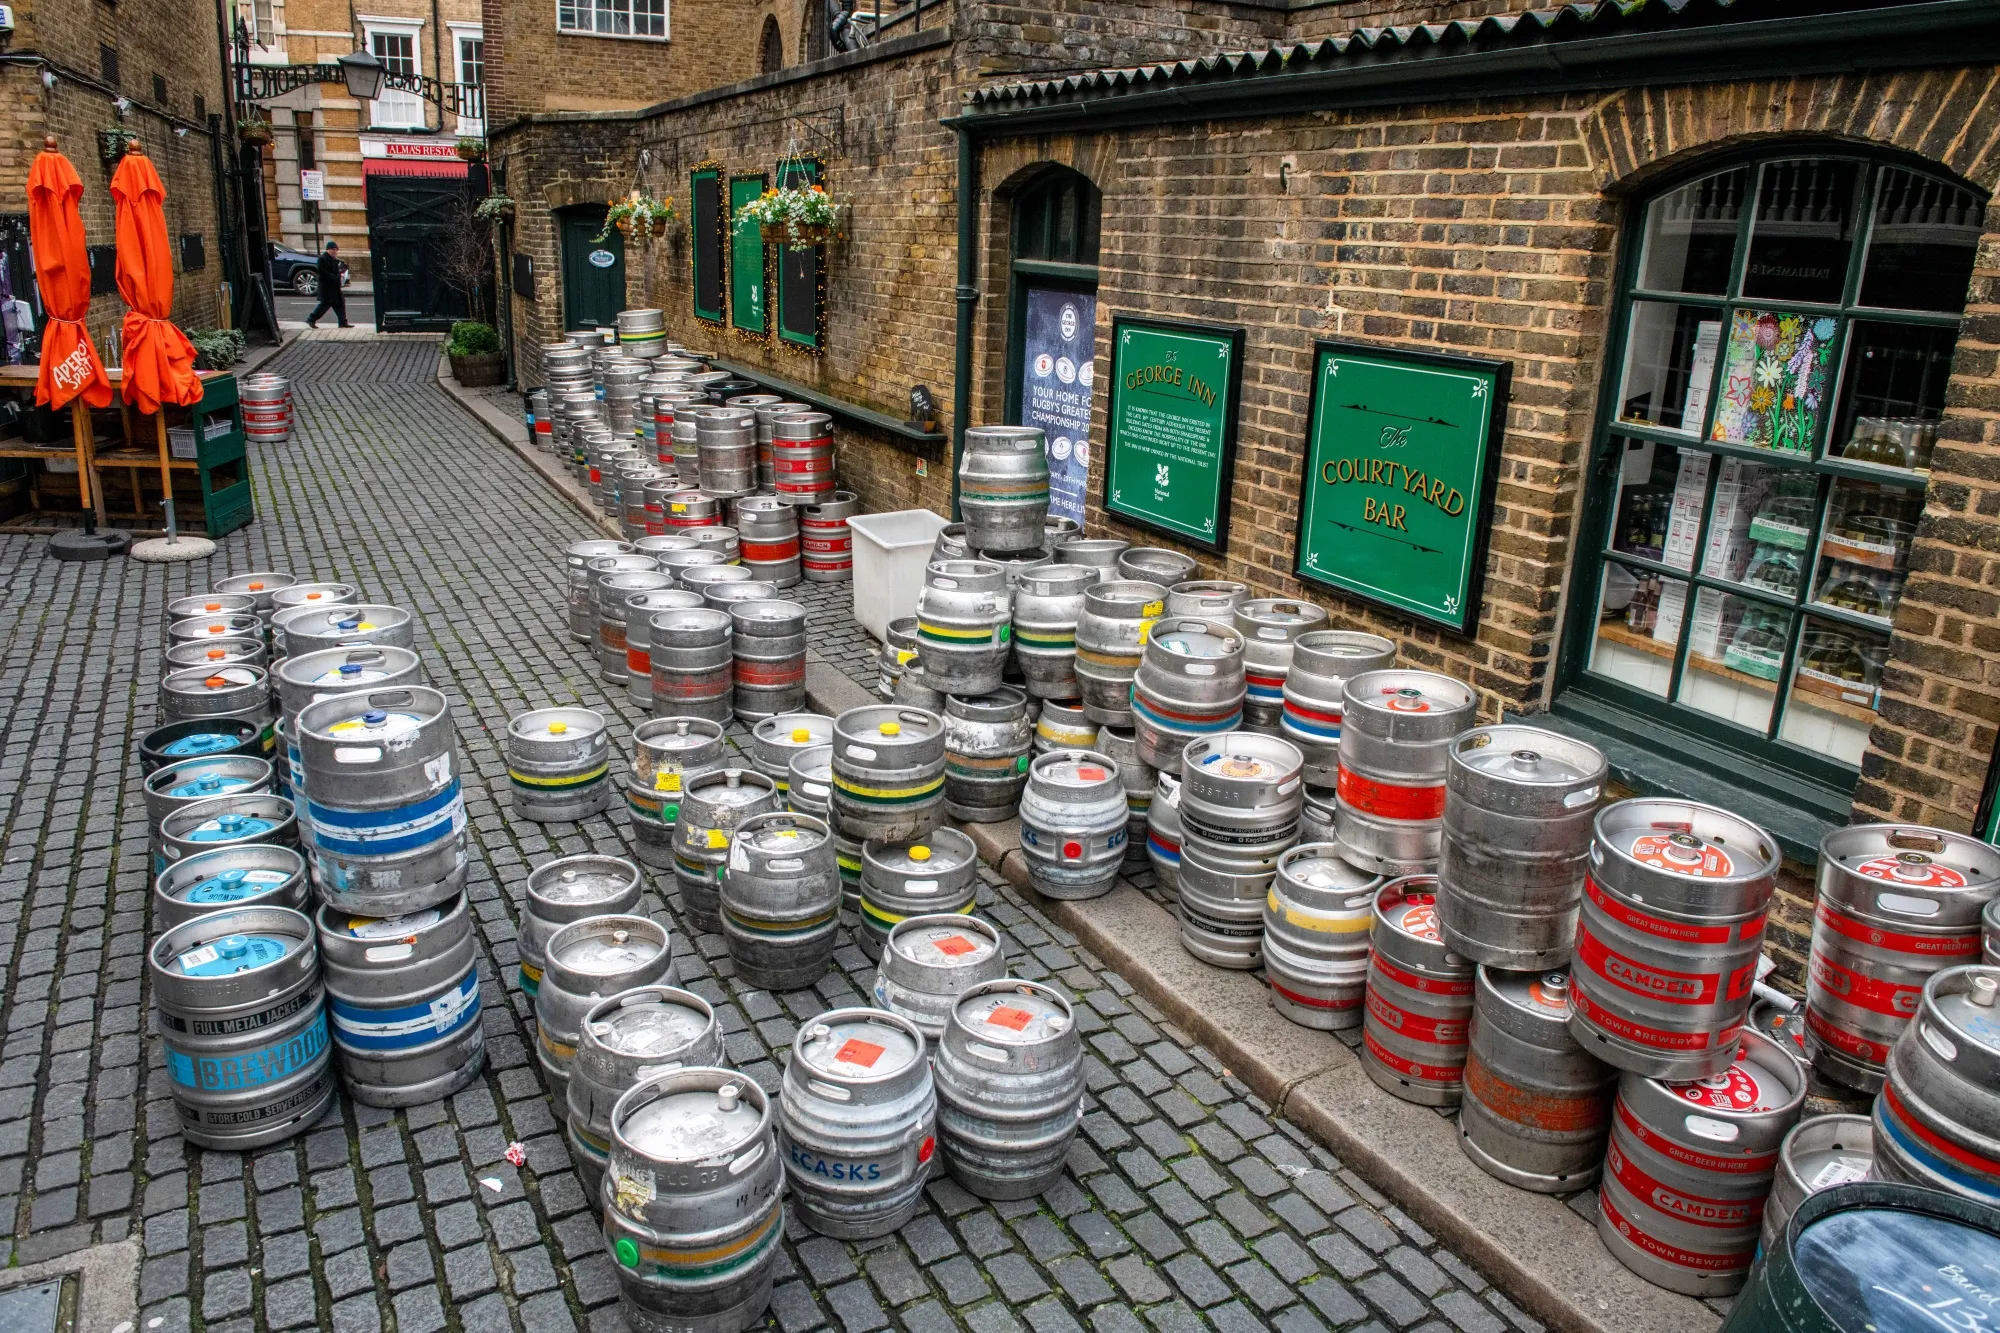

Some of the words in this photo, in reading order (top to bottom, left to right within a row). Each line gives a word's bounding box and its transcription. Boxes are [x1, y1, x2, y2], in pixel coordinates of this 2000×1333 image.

[389, 145, 421, 155] ALMA'S
[1126, 365, 1182, 390] GEORGE
[1187, 374, 1217, 408] INN
[1033, 386, 1053, 399] YOUR
[1055, 390, 1079, 405] HOME
[1032, 397, 1060, 413] RUGBY'S
[1031, 410, 1081, 431] CHAMPIONSHIP
[1166, 413, 1181, 422] GEORGE
[1189, 418, 1206, 427] EXISTED
[1161, 433, 1185, 444] HOSPITALITY
[1180, 431, 1207, 442] SHAKESPEARE
[1194, 427, 1212, 436] PRESENT
[1379, 425, 1413, 449] The
[1190, 447, 1207, 456] PRESENT
[1177, 456, 1196, 466] NATIONAL
[1196, 460, 1209, 469] TRUST
[1154, 487, 1170, 498] National
[1322, 458, 1464, 517] COURTYARD
[1061, 498, 1077, 511] HERE
[1363, 497, 1408, 532] BAR
[1759, 519, 1790, 531] FEVER-TREE
[1828, 534, 1860, 548] FEVER-TREE
[1732, 648, 1764, 662] FEVER-TREE
[1805, 669, 1839, 684] FEVER-TREE
[1208, 832, 1231, 843] Kegstar
[1245, 836, 1269, 844] Kegstar
[1196, 920, 1217, 933] Kegstar
[1230, 929, 1255, 937] Kegstar
[1627, 913, 1650, 928] GREAT
[1650, 923, 1670, 934] BEER
[1670, 927, 1679, 937] IN
[1679, 929, 1700, 939] HERE
[1915, 942, 1941, 951] GREAT
[1610, 962, 1696, 995] CAMDEN
[195, 1020, 222, 1035] FULL
[224, 1014, 264, 1034] METAL
[266, 997, 301, 1024] JACKET
[1600, 1013, 1631, 1035] TOWN
[1634, 1029, 1693, 1046] BREWERY
[203, 1020, 327, 1087] BREWDOG
[208, 1112, 236, 1124] STORE
[265, 1101, 292, 1117] SERVE
[791, 1144, 881, 1181] ECASKS
[1669, 1147, 1694, 1162] GREAT
[1695, 1156, 1716, 1167] BEER
[1717, 1160, 1727, 1169] IN
[1728, 1161, 1748, 1170] HERE
[1658, 1194, 1745, 1220] CAMDEN
[1641, 1237, 1676, 1258] TOWN
[1679, 1254, 1737, 1267] BREWERY
